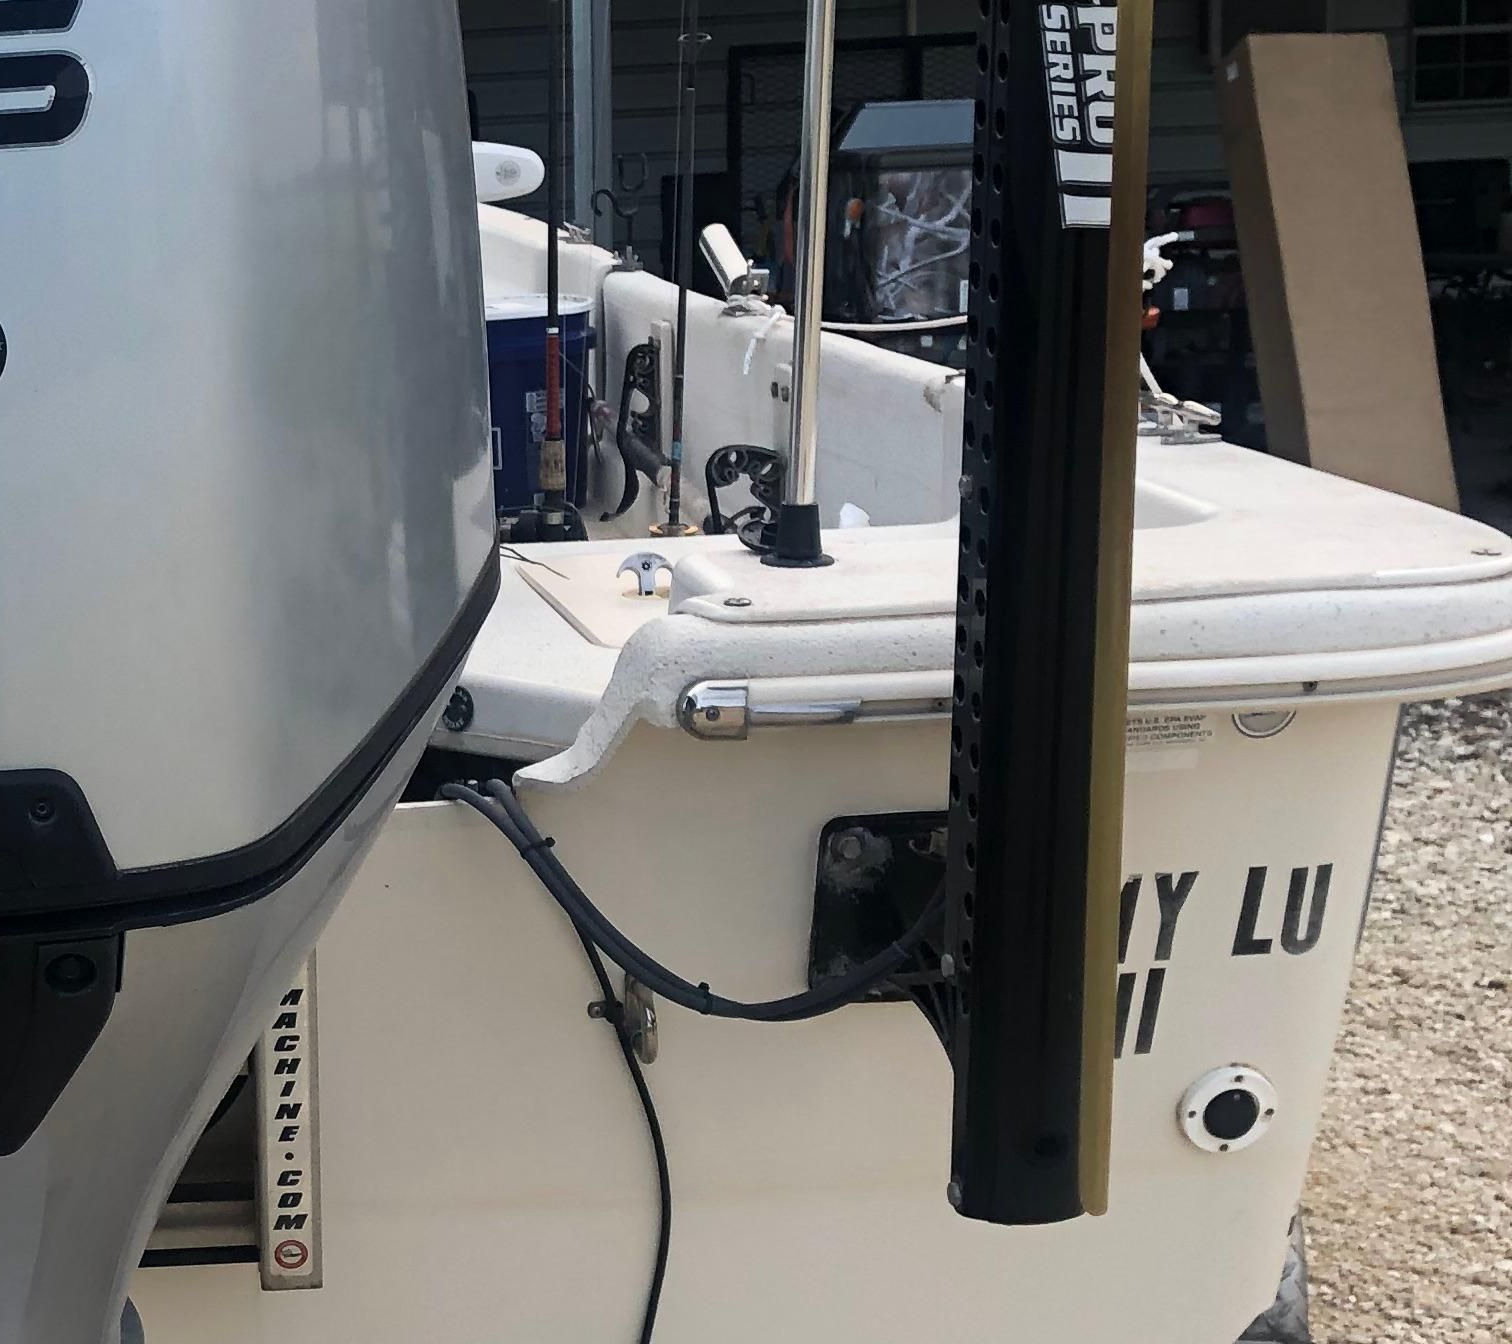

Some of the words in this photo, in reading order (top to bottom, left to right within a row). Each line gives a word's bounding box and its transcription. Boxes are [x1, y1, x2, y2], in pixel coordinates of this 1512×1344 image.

[1041, 4, 1082, 143] SERIES
[1075, 6, 1118, 146] PRO
[1232, 862, 1334, 957] LU
